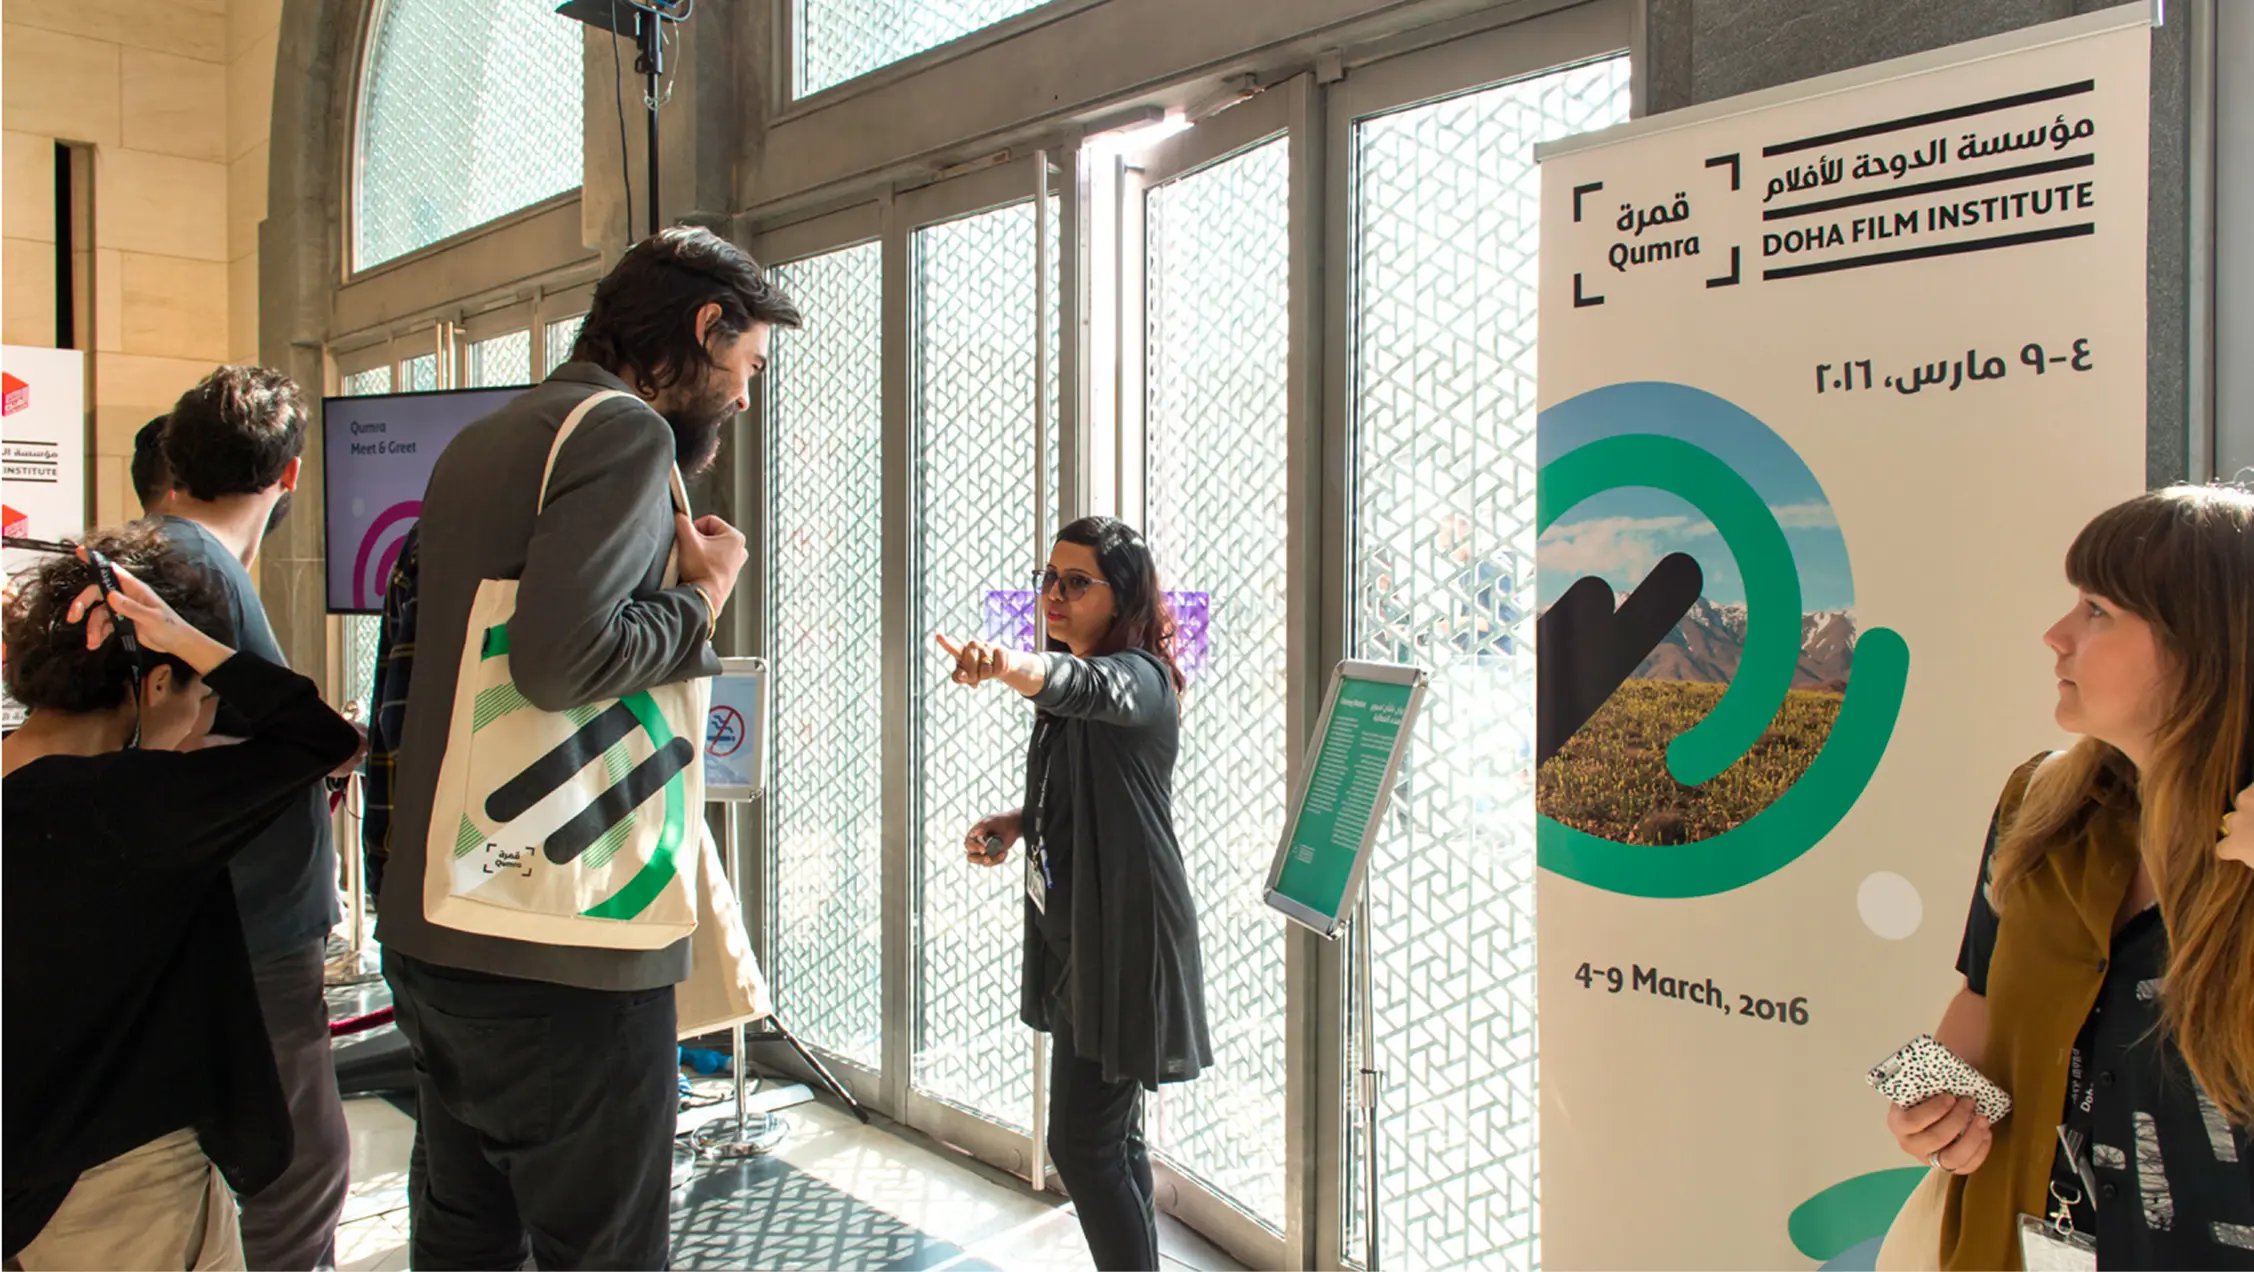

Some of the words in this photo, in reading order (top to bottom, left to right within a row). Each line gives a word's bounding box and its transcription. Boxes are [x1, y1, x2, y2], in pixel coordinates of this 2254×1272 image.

[1852, 138, 1947, 180] الدوحة
[1957, 114, 2094, 160] مؤسسة
[1763, 155, 1844, 202] للأفلام
[1617, 191, 1690, 237] قمرة
[1763, 223, 1844, 257] DOHA
[1852, 210, 1918, 242] FILM
[1928, 181, 2094, 231] INSTITUTE
[1608, 236, 1700, 272] Qumra
[1816, 359, 1872, 394] ٢٠١٦
[1884, 349, 2006, 395] مارس،
[350, 421, 386, 436] Qumra
[350, 442, 377, 455] Meet
[379, 441, 386, 454] &
[388, 441, 416, 454] Greet
[3, 467, 58, 476] INSTITUTE
[1574, 962, 1623, 993] 4-9
[1632, 964, 1731, 1015] March,
[1739, 994, 1809, 1026] 2016
